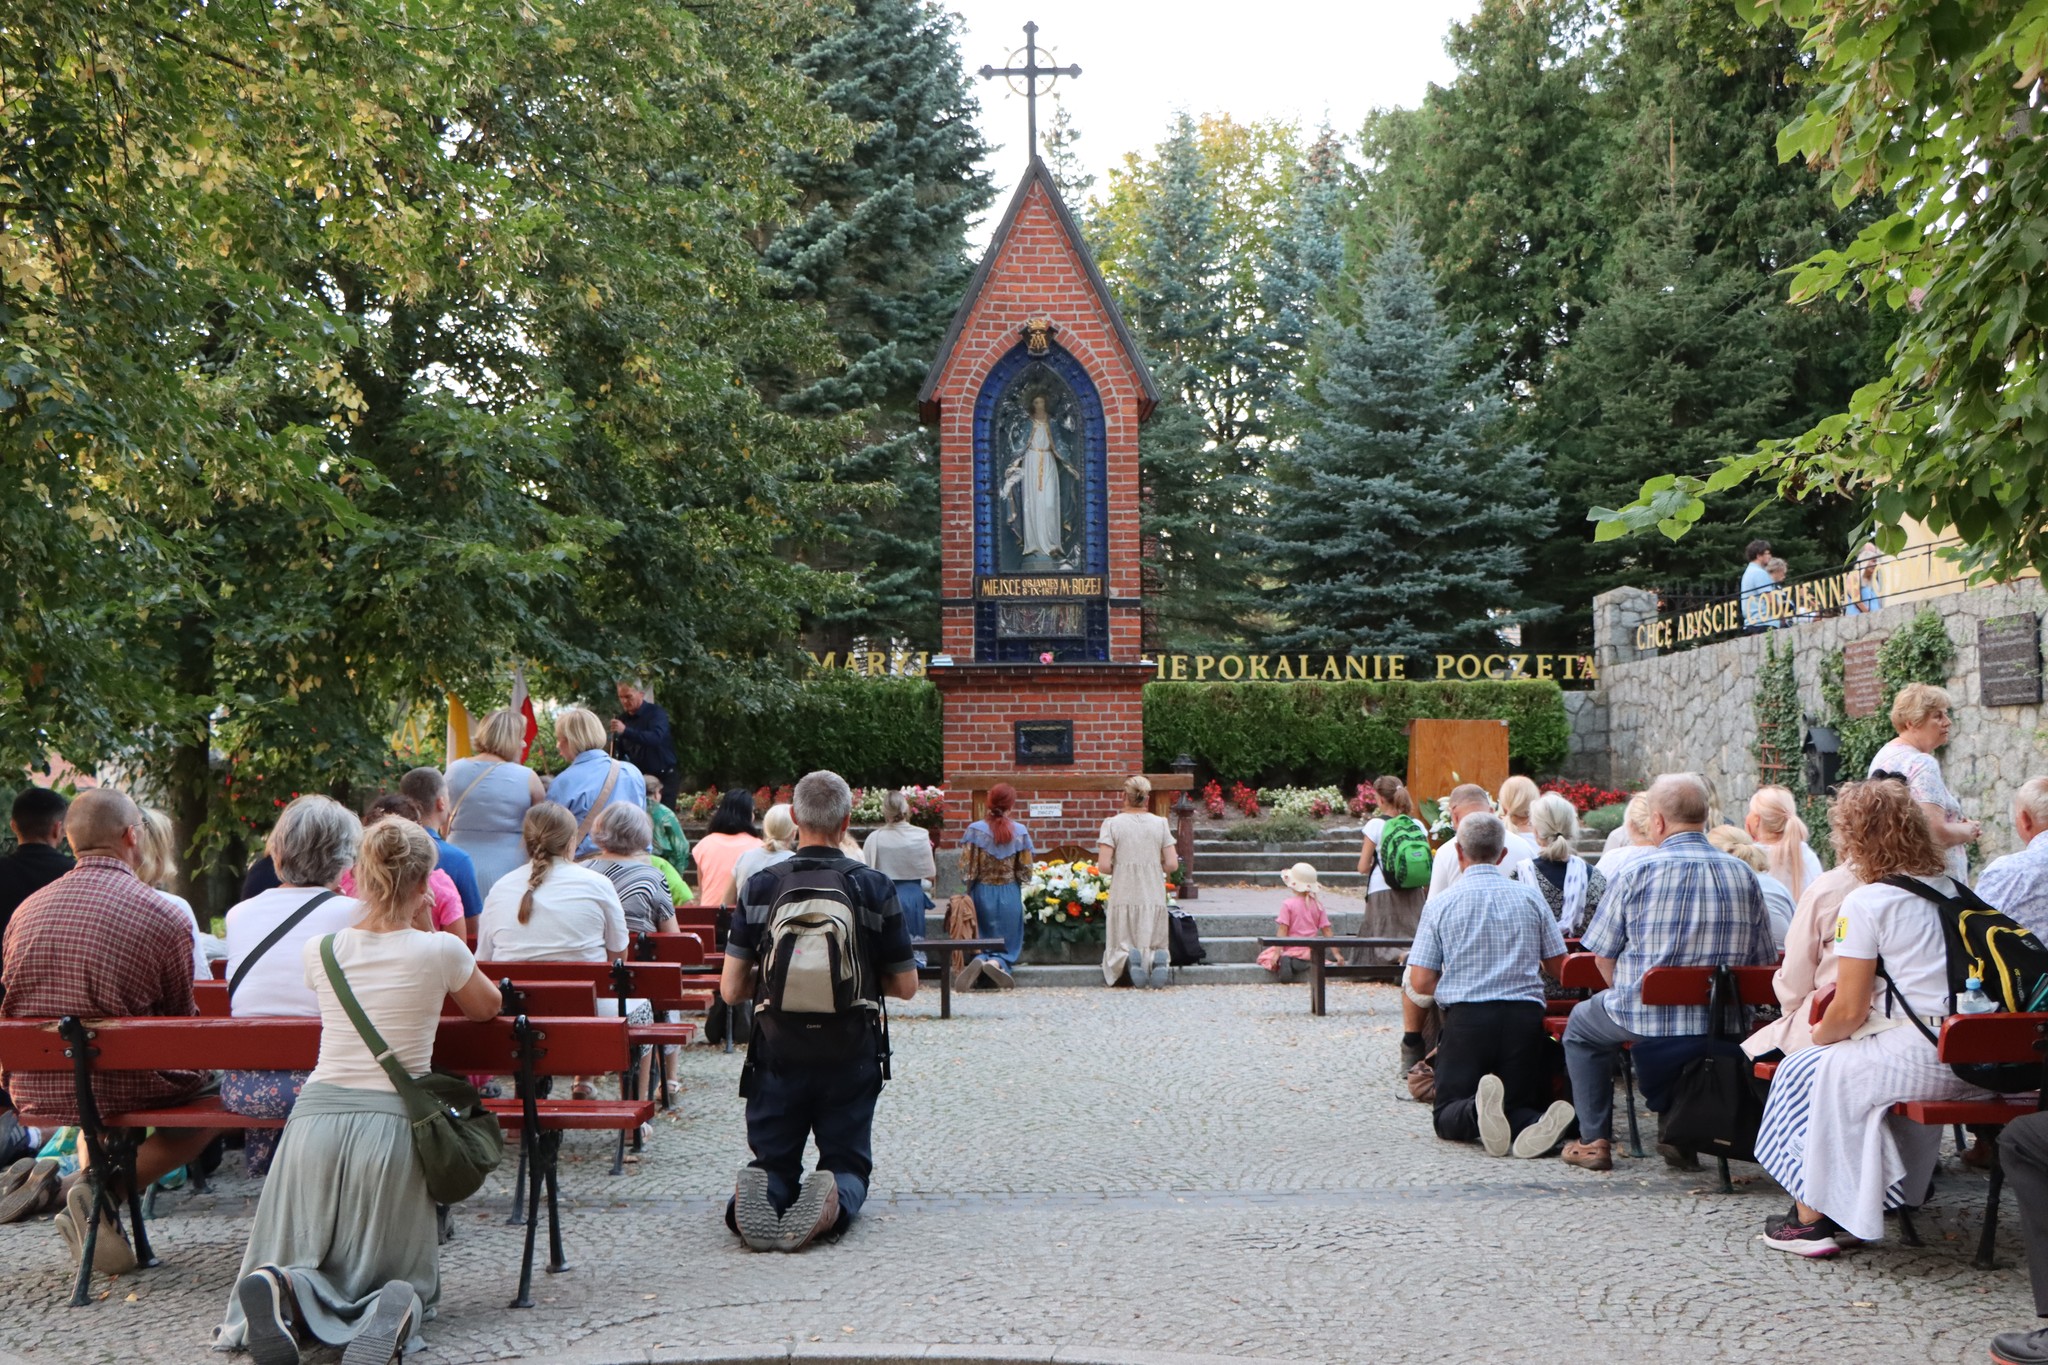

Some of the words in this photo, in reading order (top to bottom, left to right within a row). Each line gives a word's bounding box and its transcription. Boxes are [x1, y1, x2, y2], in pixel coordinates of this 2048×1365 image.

[982, 579, 1021, 596] MIEJSCE
[1636, 618, 1673, 650] CHCĘ
[1677, 600, 1738, 641] ABYŚCIE
[1746, 570, 1861, 625] CODZIENNIE
[805, 651, 942, 678] MARYJ
[1141, 654, 1405, 681] IEPOKALANIE
